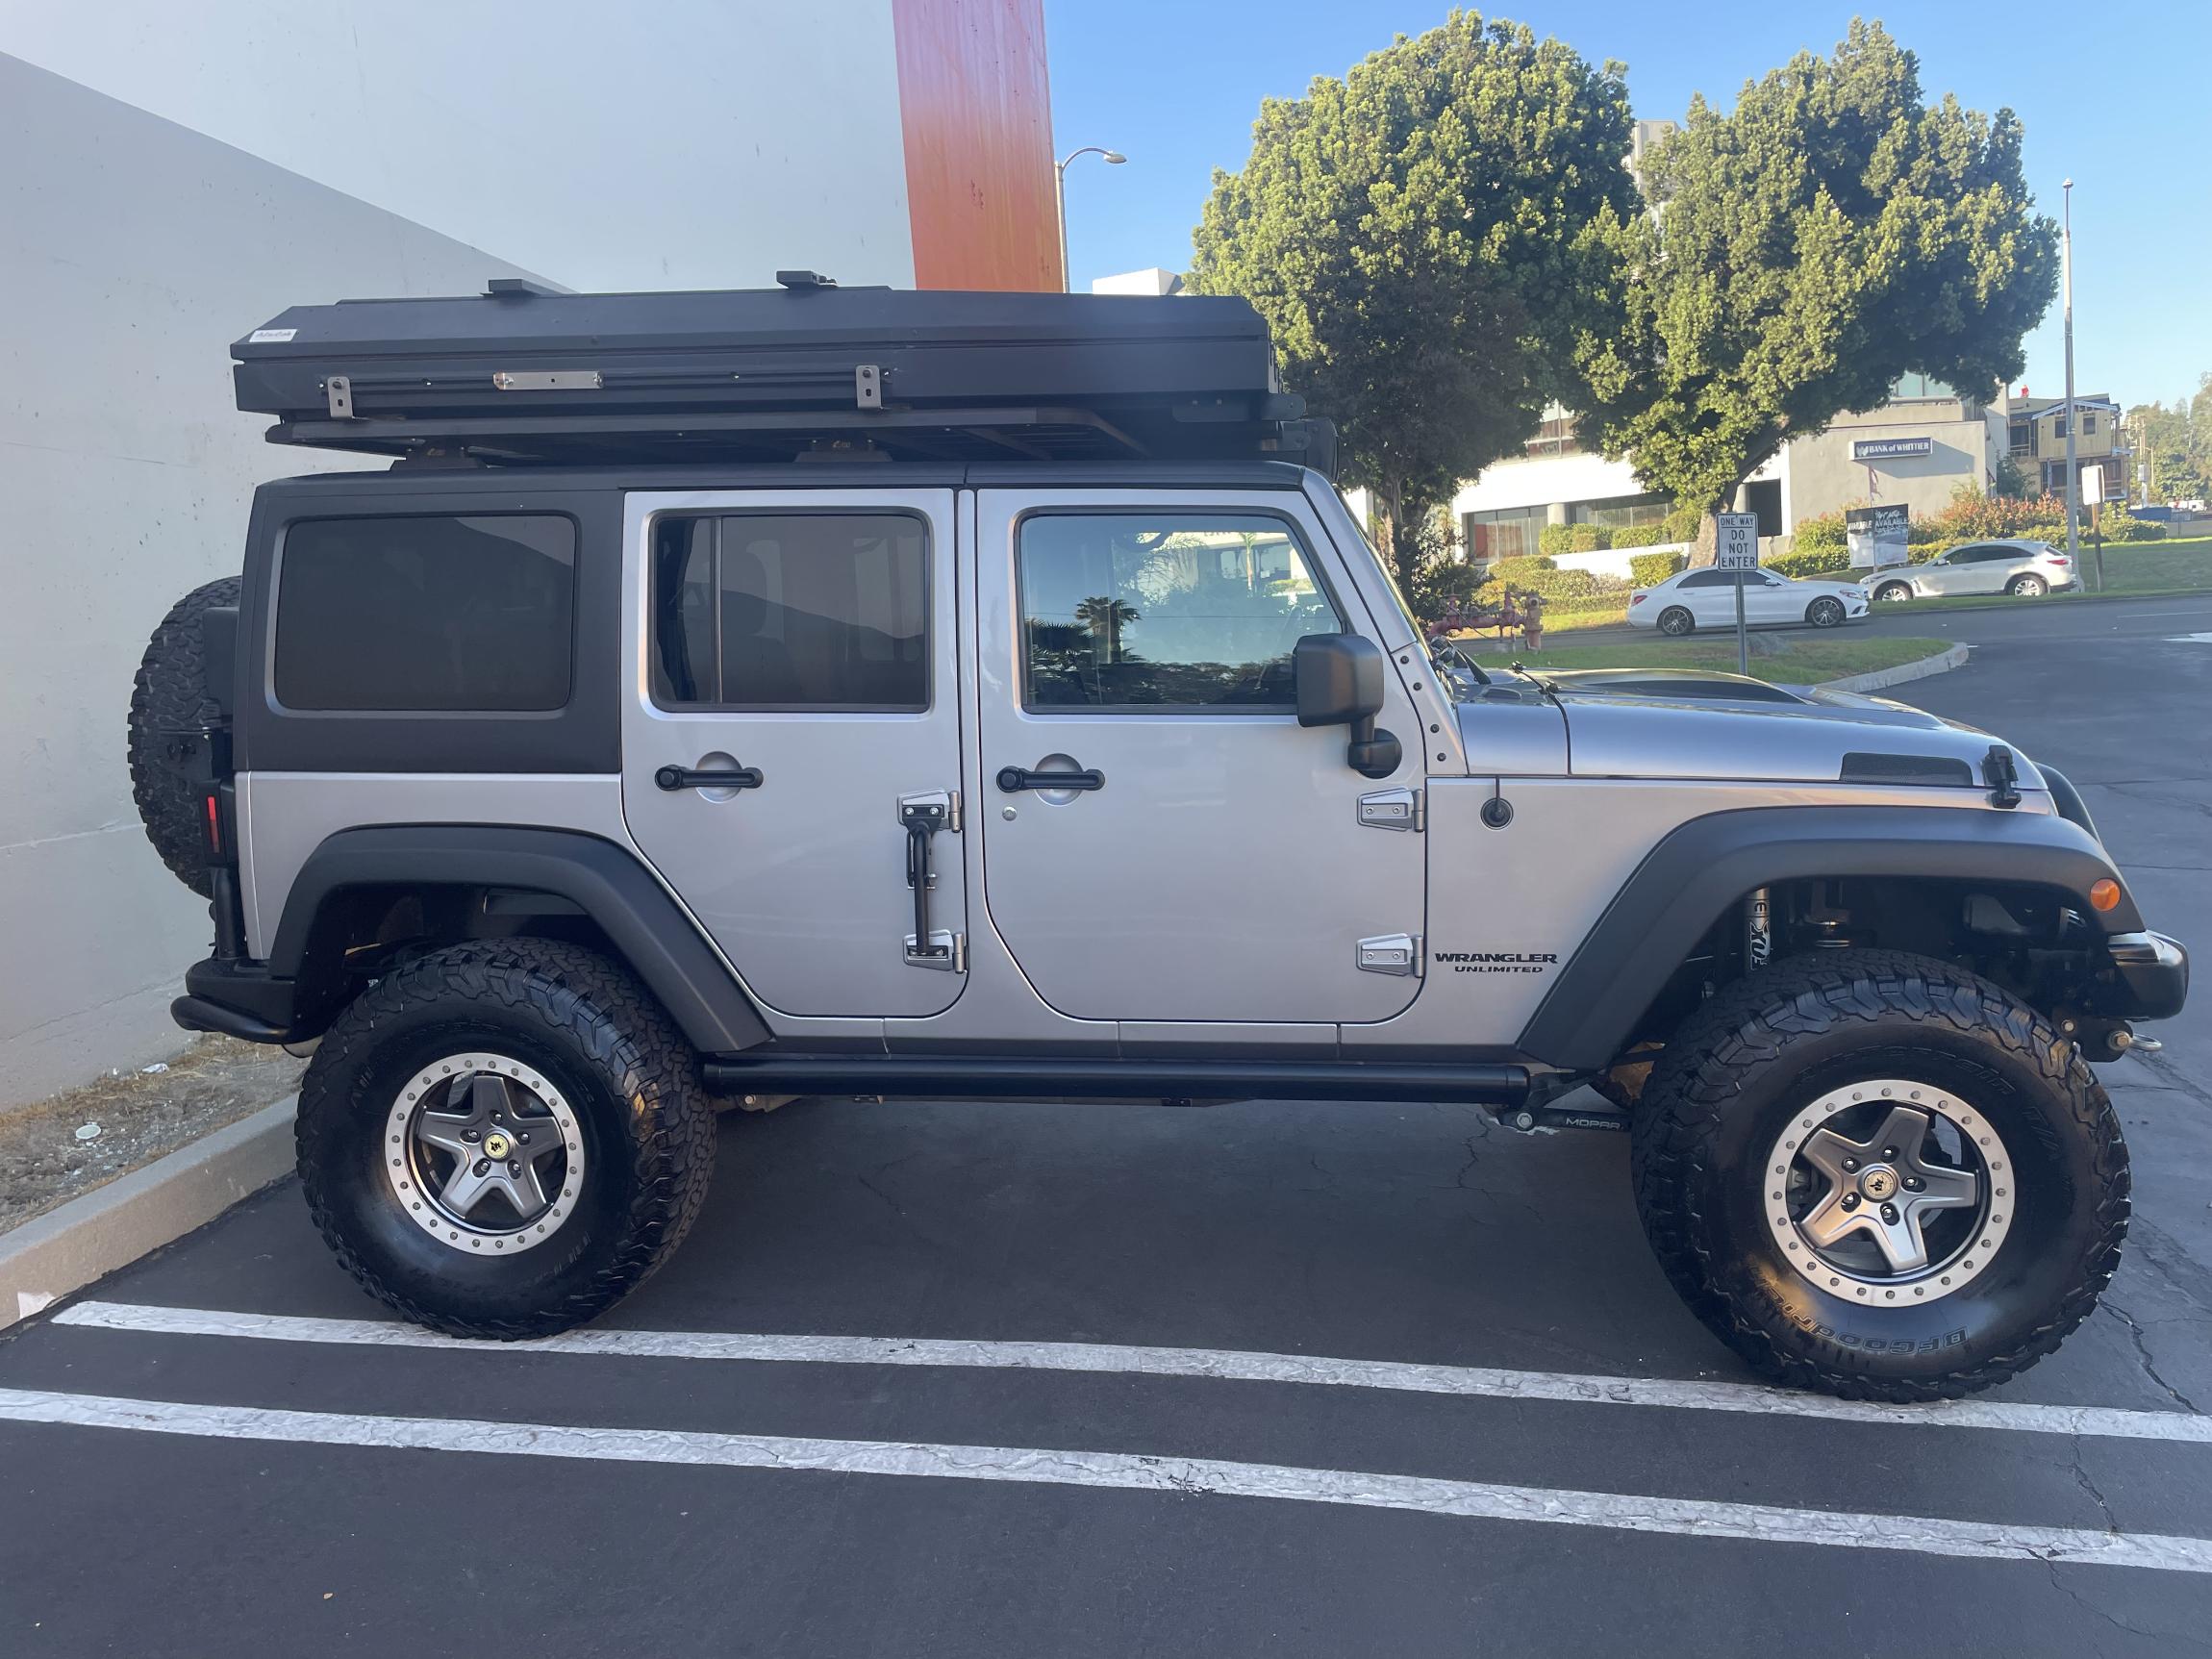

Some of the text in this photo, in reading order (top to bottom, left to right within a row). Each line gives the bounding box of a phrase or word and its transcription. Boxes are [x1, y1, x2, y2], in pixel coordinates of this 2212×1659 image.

[1869, 444, 1888, 454] BANK
[1896, 441, 1929, 452] WHITTIER
[1720, 516, 1754, 526] ONE WAY
[1731, 529, 1746, 540] DO
[1728, 542, 1748, 554] NOT
[1722, 557, 1755, 568] ENTER
[1749, 920, 1770, 971] FOX
[1435, 952, 1559, 964] WRANGLER
[1566, 1118, 1621, 1131] MOPAR
